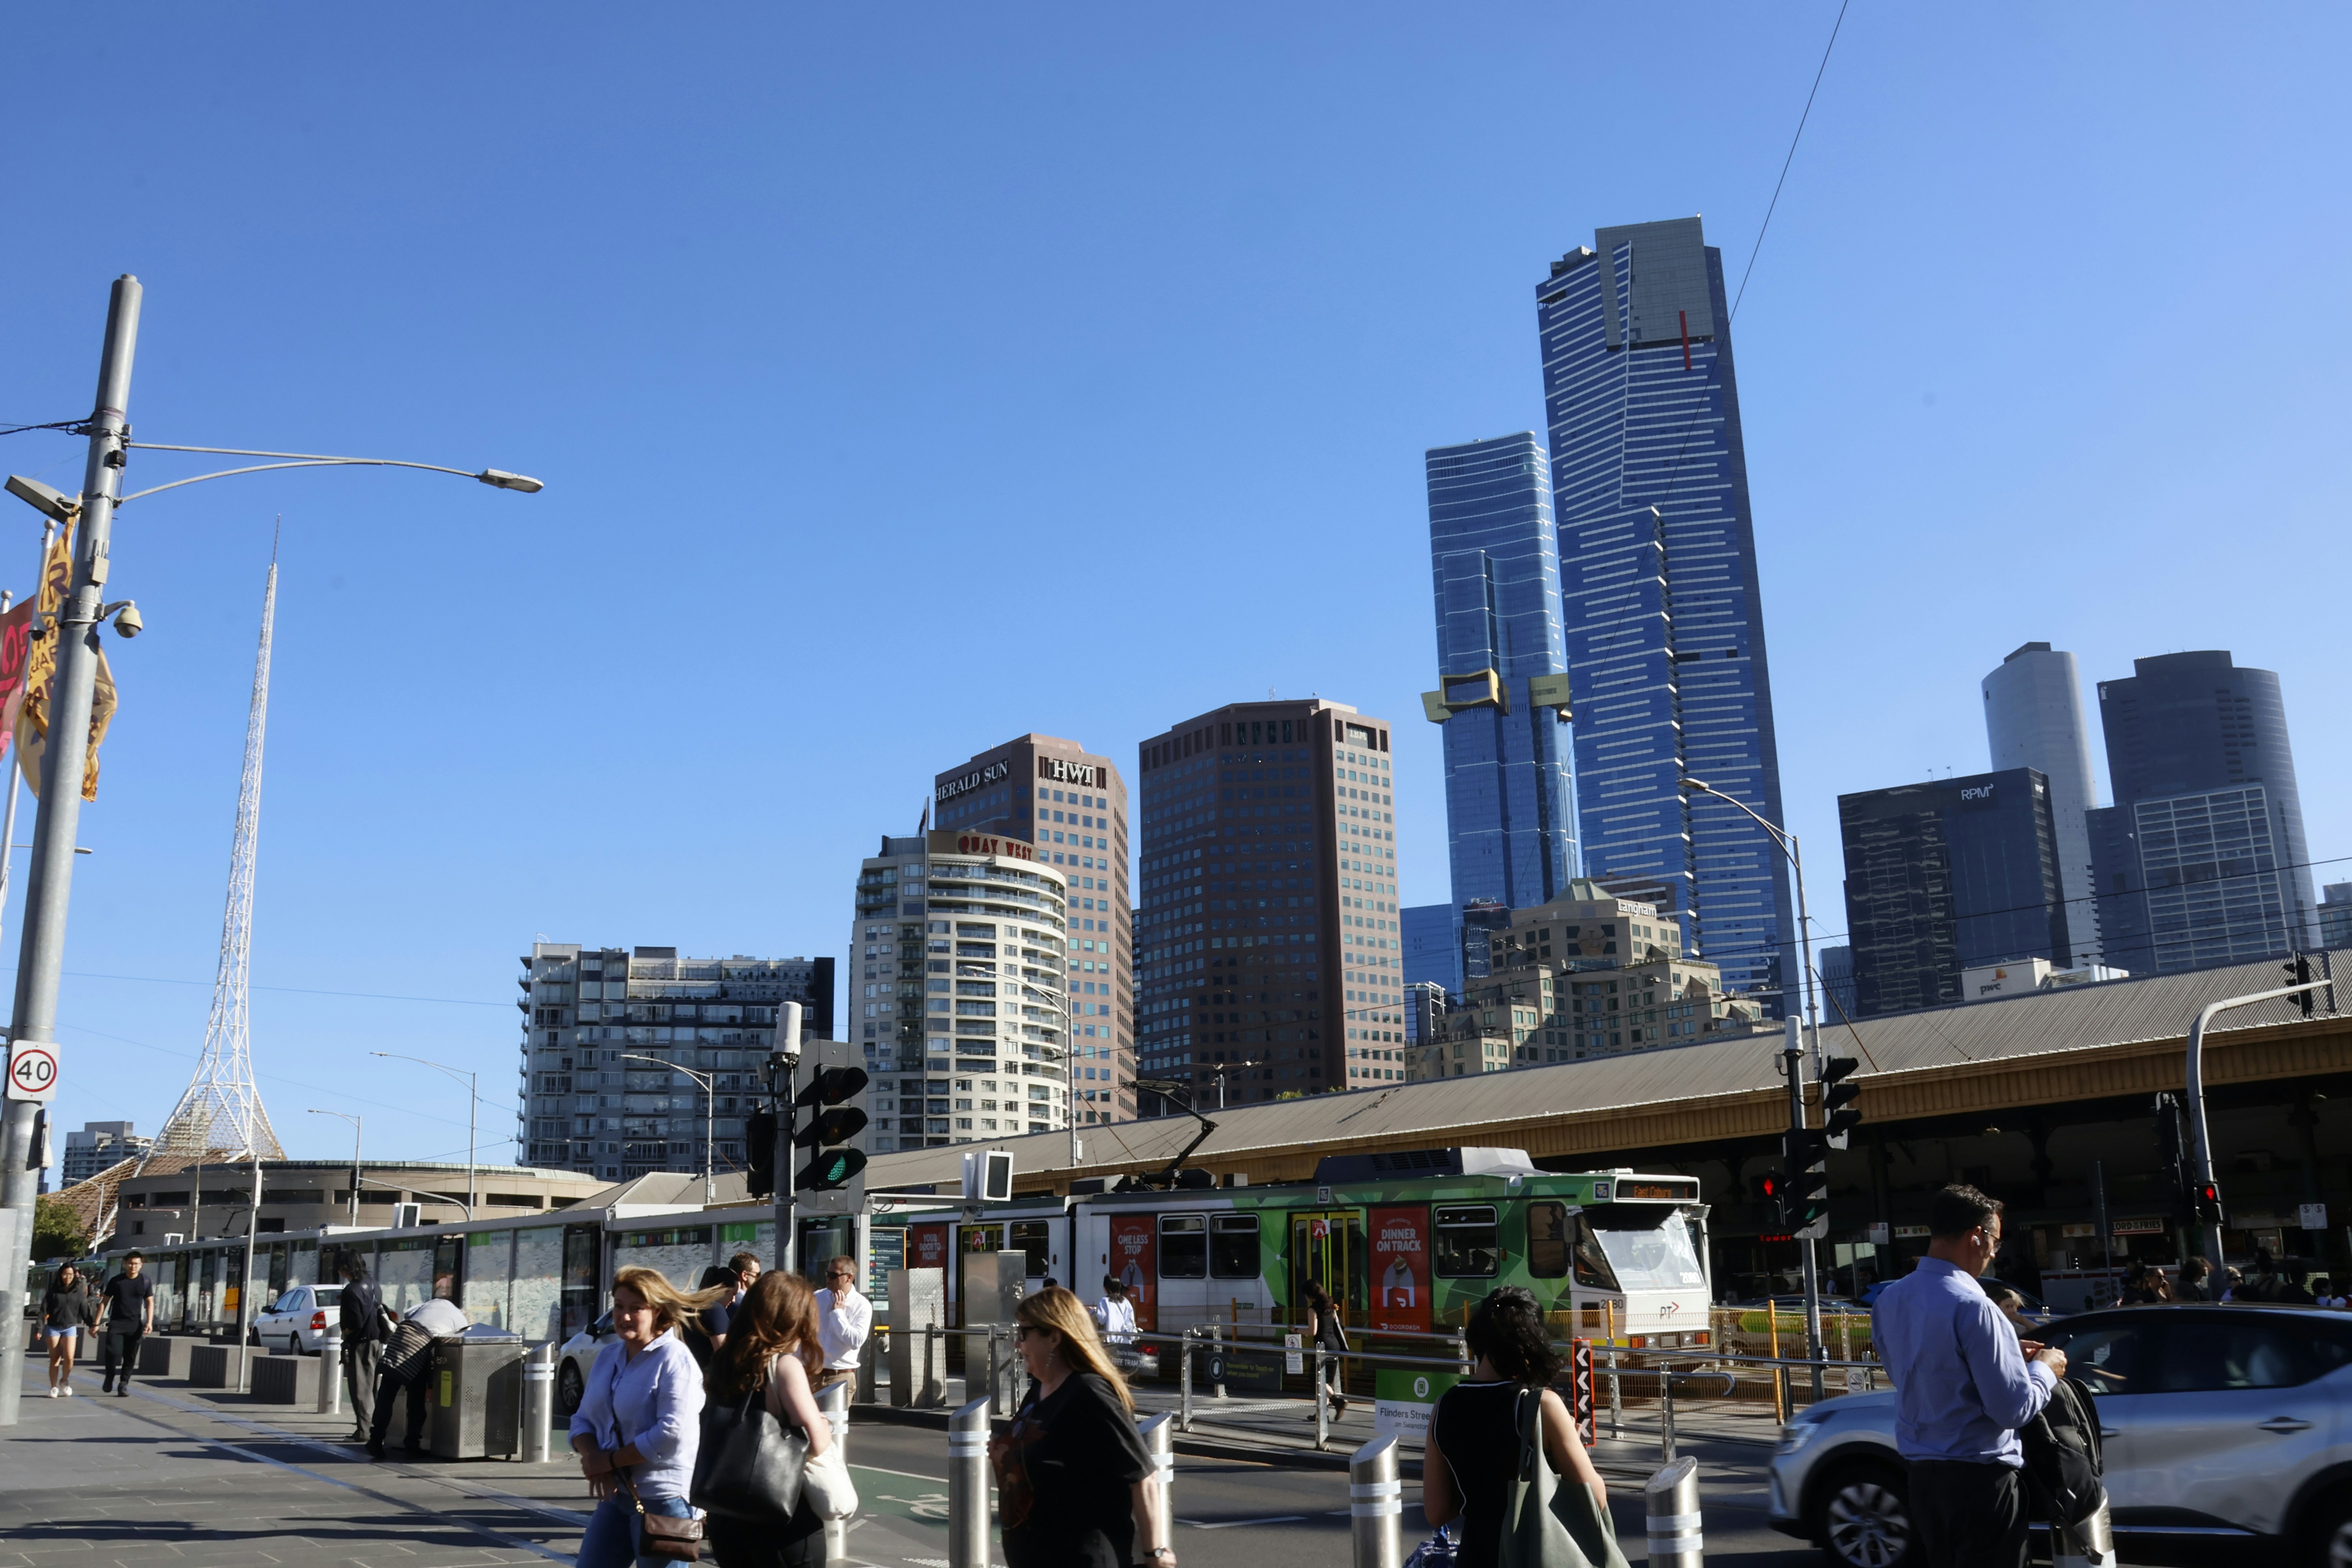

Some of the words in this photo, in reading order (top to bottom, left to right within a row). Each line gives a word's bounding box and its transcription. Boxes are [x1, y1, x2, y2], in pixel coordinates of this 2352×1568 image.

[1350, 729, 1367, 740] IBM
[1053, 760, 1095, 783] HWT
[935, 772, 980, 802] HERALD
[984, 760, 1008, 782] SUN
[960, 835, 998, 855] QUAY
[1005, 842, 1032, 861] WEST
[1617, 899, 1657, 917] Langham
[1980, 983, 2001, 995] pwc
[16, 1060, 51, 1082] 40
[2140, 1220, 2161, 1229] FRIES
[923, 1234, 937, 1242] YOUR
[1118, 1234, 1132, 1244] ONE
[1133, 1234, 1148, 1245] LESS
[1381, 1228, 1416, 1240] DINNER
[919, 1243, 933, 1251] DOOR
[933, 1242, 941, 1250] TO
[1124, 1245, 1142, 1254] STOP
[1377, 1240, 1390, 1252] ON
[1391, 1240, 1421, 1252] TRACK
[923, 1252, 937, 1260] MORE
[1679, 1272, 1701, 1283] 2080
[1601, 1299, 1623, 1309] 280
[1124, 1358, 1138, 1367] TRAM
[1380, 1407, 1409, 1418] Flinders
[1410, 1410, 1430, 1420] Stree
